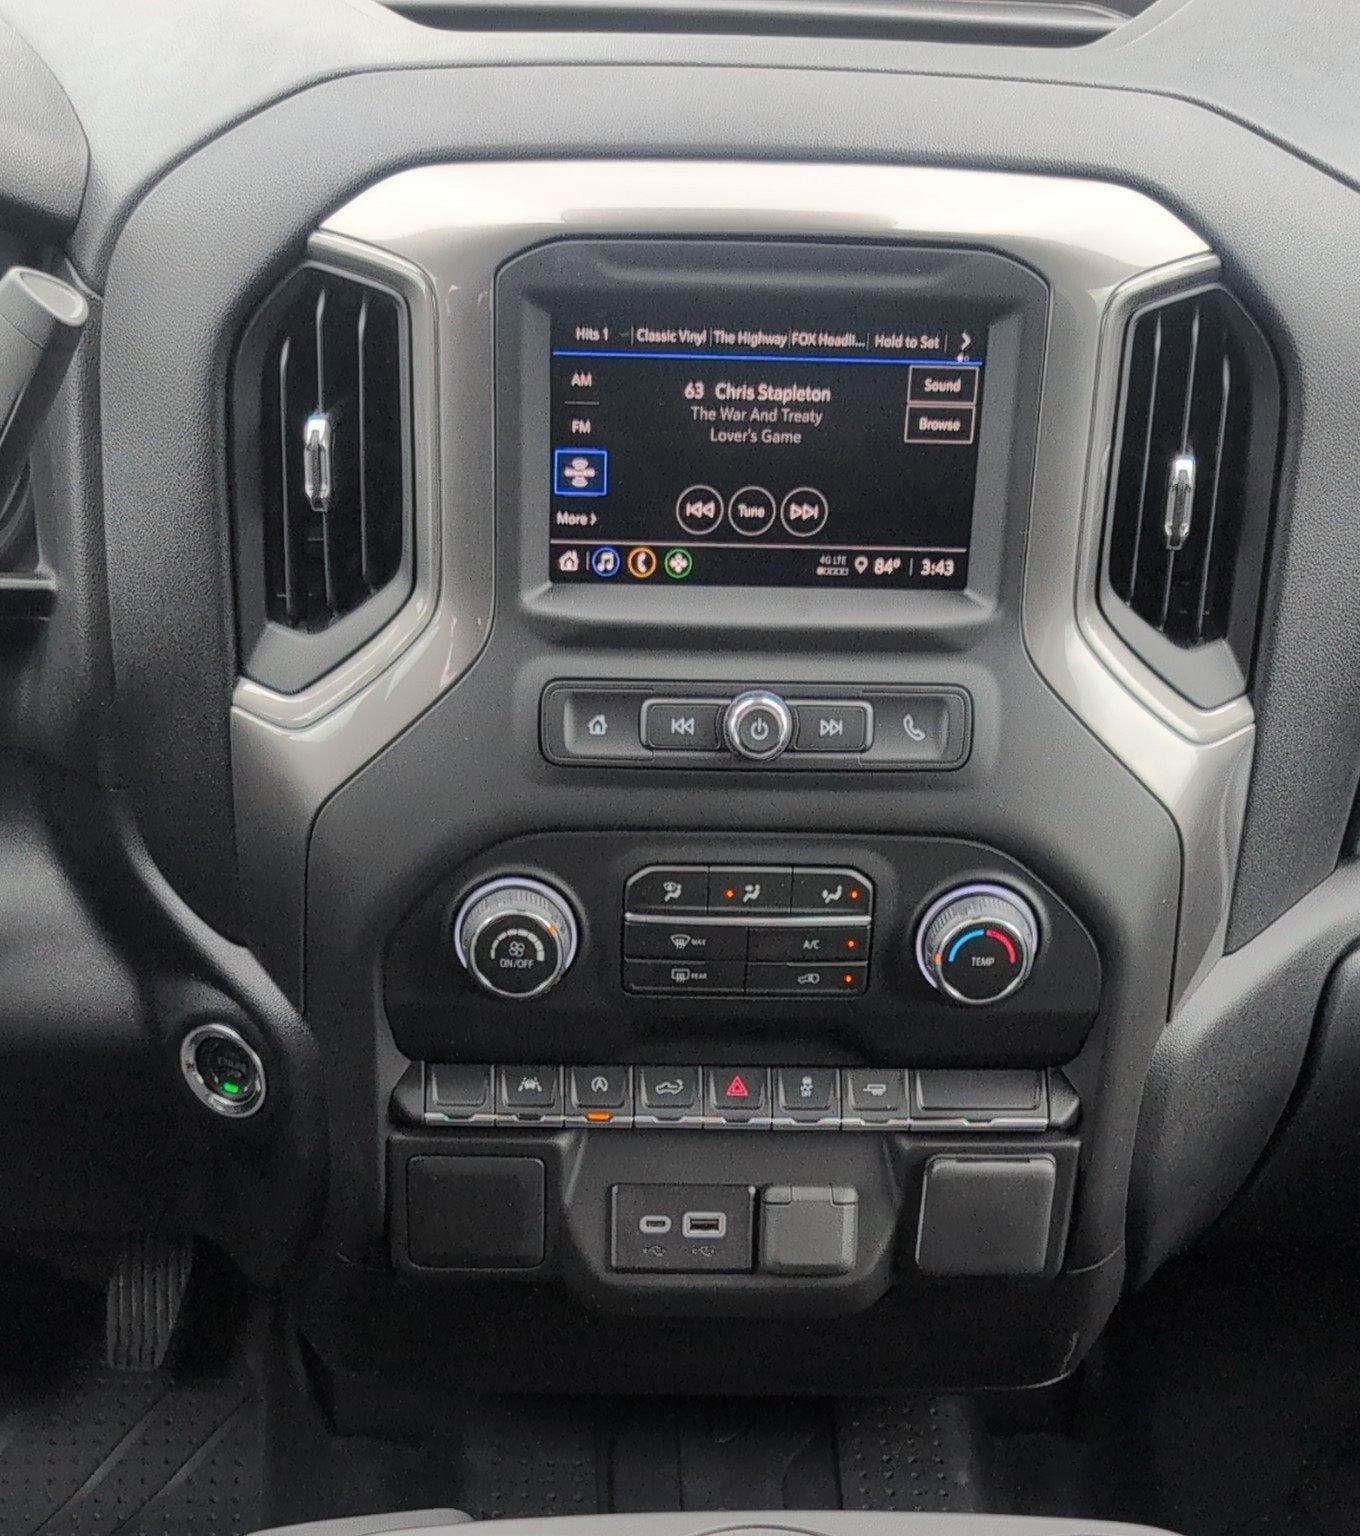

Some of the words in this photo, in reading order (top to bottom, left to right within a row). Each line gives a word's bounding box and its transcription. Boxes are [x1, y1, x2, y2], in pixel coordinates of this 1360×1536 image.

[575, 326, 600, 342] Hits
[636, 328, 677, 343] Classic
[680, 329, 707, 347] Vinyl
[714, 330, 735, 344] The
[737, 330, 788, 348] Highway
[792, 332, 816, 346] FOX
[874, 334, 902, 348] Hold
[904, 336, 918, 349] to
[919, 335, 940, 349] Set
[570, 372, 593, 387] AM
[923, 377, 962, 393] Sound
[684, 382, 705, 400] 63
[715, 382, 755, 400] Chris
[757, 383, 832, 405] Stapleton
[690, 406, 716, 421] The
[719, 407, 747, 421] War
[749, 407, 778, 422] And
[782, 408, 823, 426] Treaty
[571, 419, 591, 434] FM
[918, 416, 961, 432] Browse
[710, 428, 758, 443] Lover's
[761, 430, 802, 445] Game
[556, 510, 588, 525] More
[738, 503, 765, 518] Tune
[920, 558, 955, 576] 3:43
[803, 940, 821, 949] A/C
[500, 958, 535, 969] ON/OFF
[971, 956, 995, 967] TEMP
